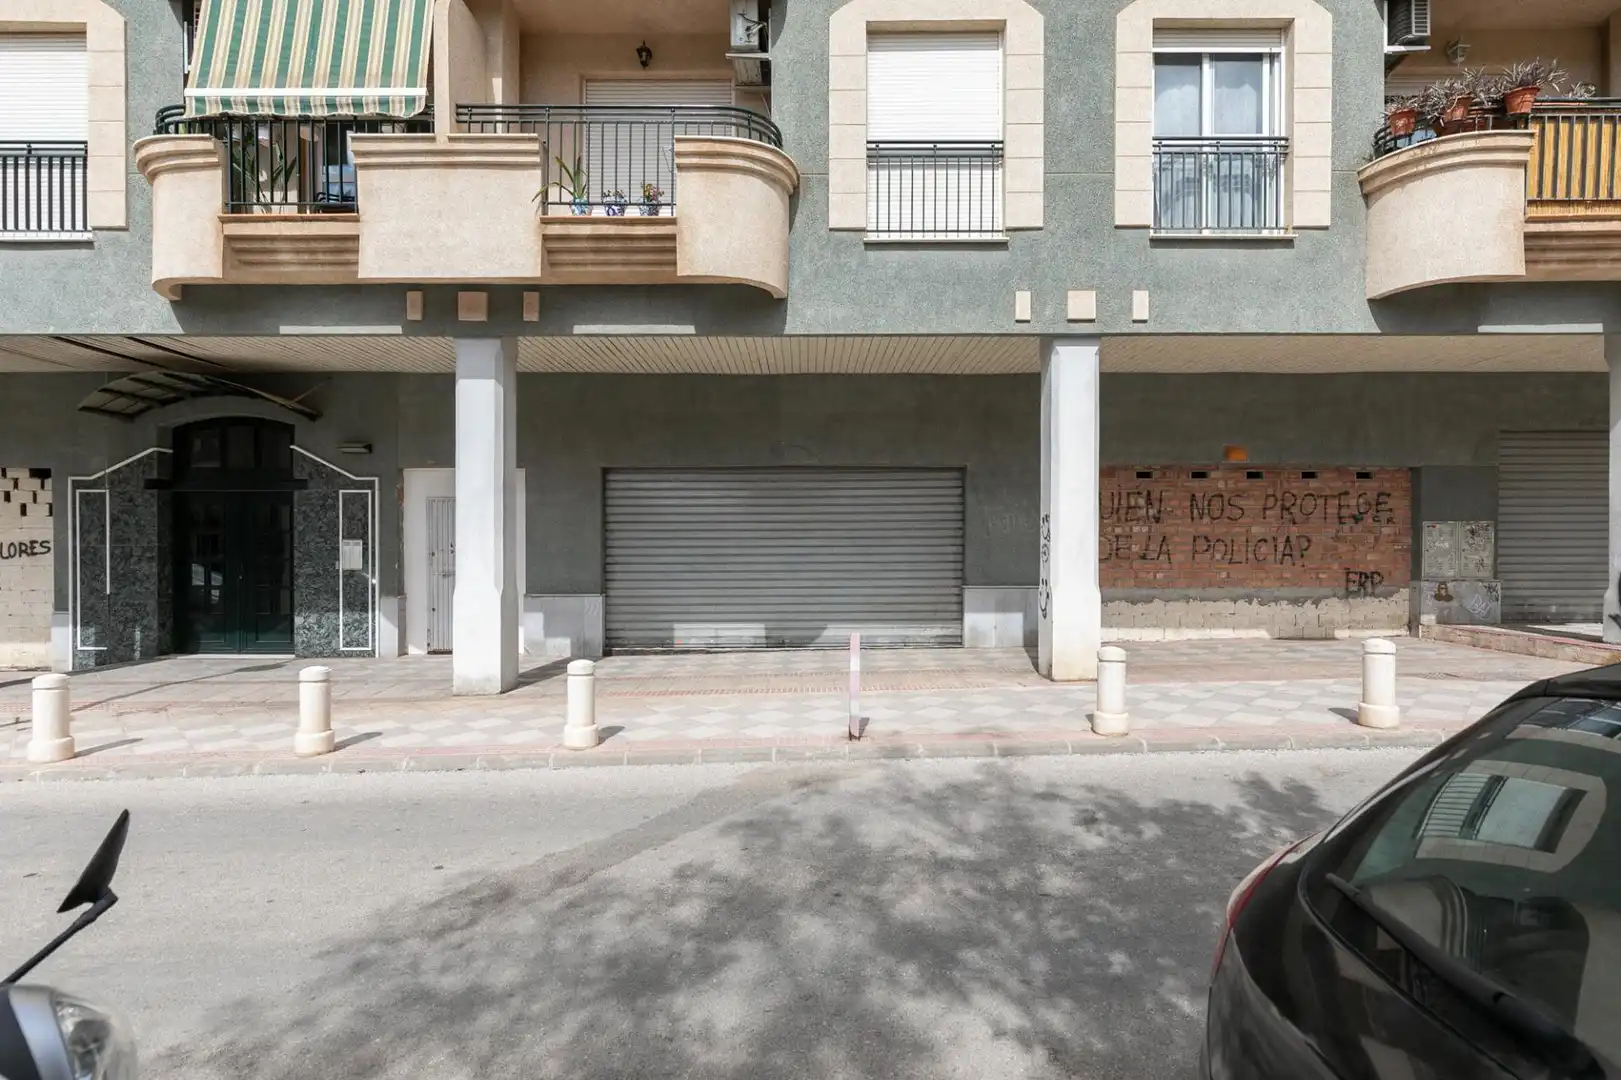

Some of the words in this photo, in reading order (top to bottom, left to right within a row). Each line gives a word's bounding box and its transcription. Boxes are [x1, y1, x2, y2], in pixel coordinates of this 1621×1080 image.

[1190, 493, 1245, 523] NOS
[1262, 490, 1393, 525] PROTEGE
[0, 540, 51, 559] LORES
[1140, 535, 1172, 564] LA
